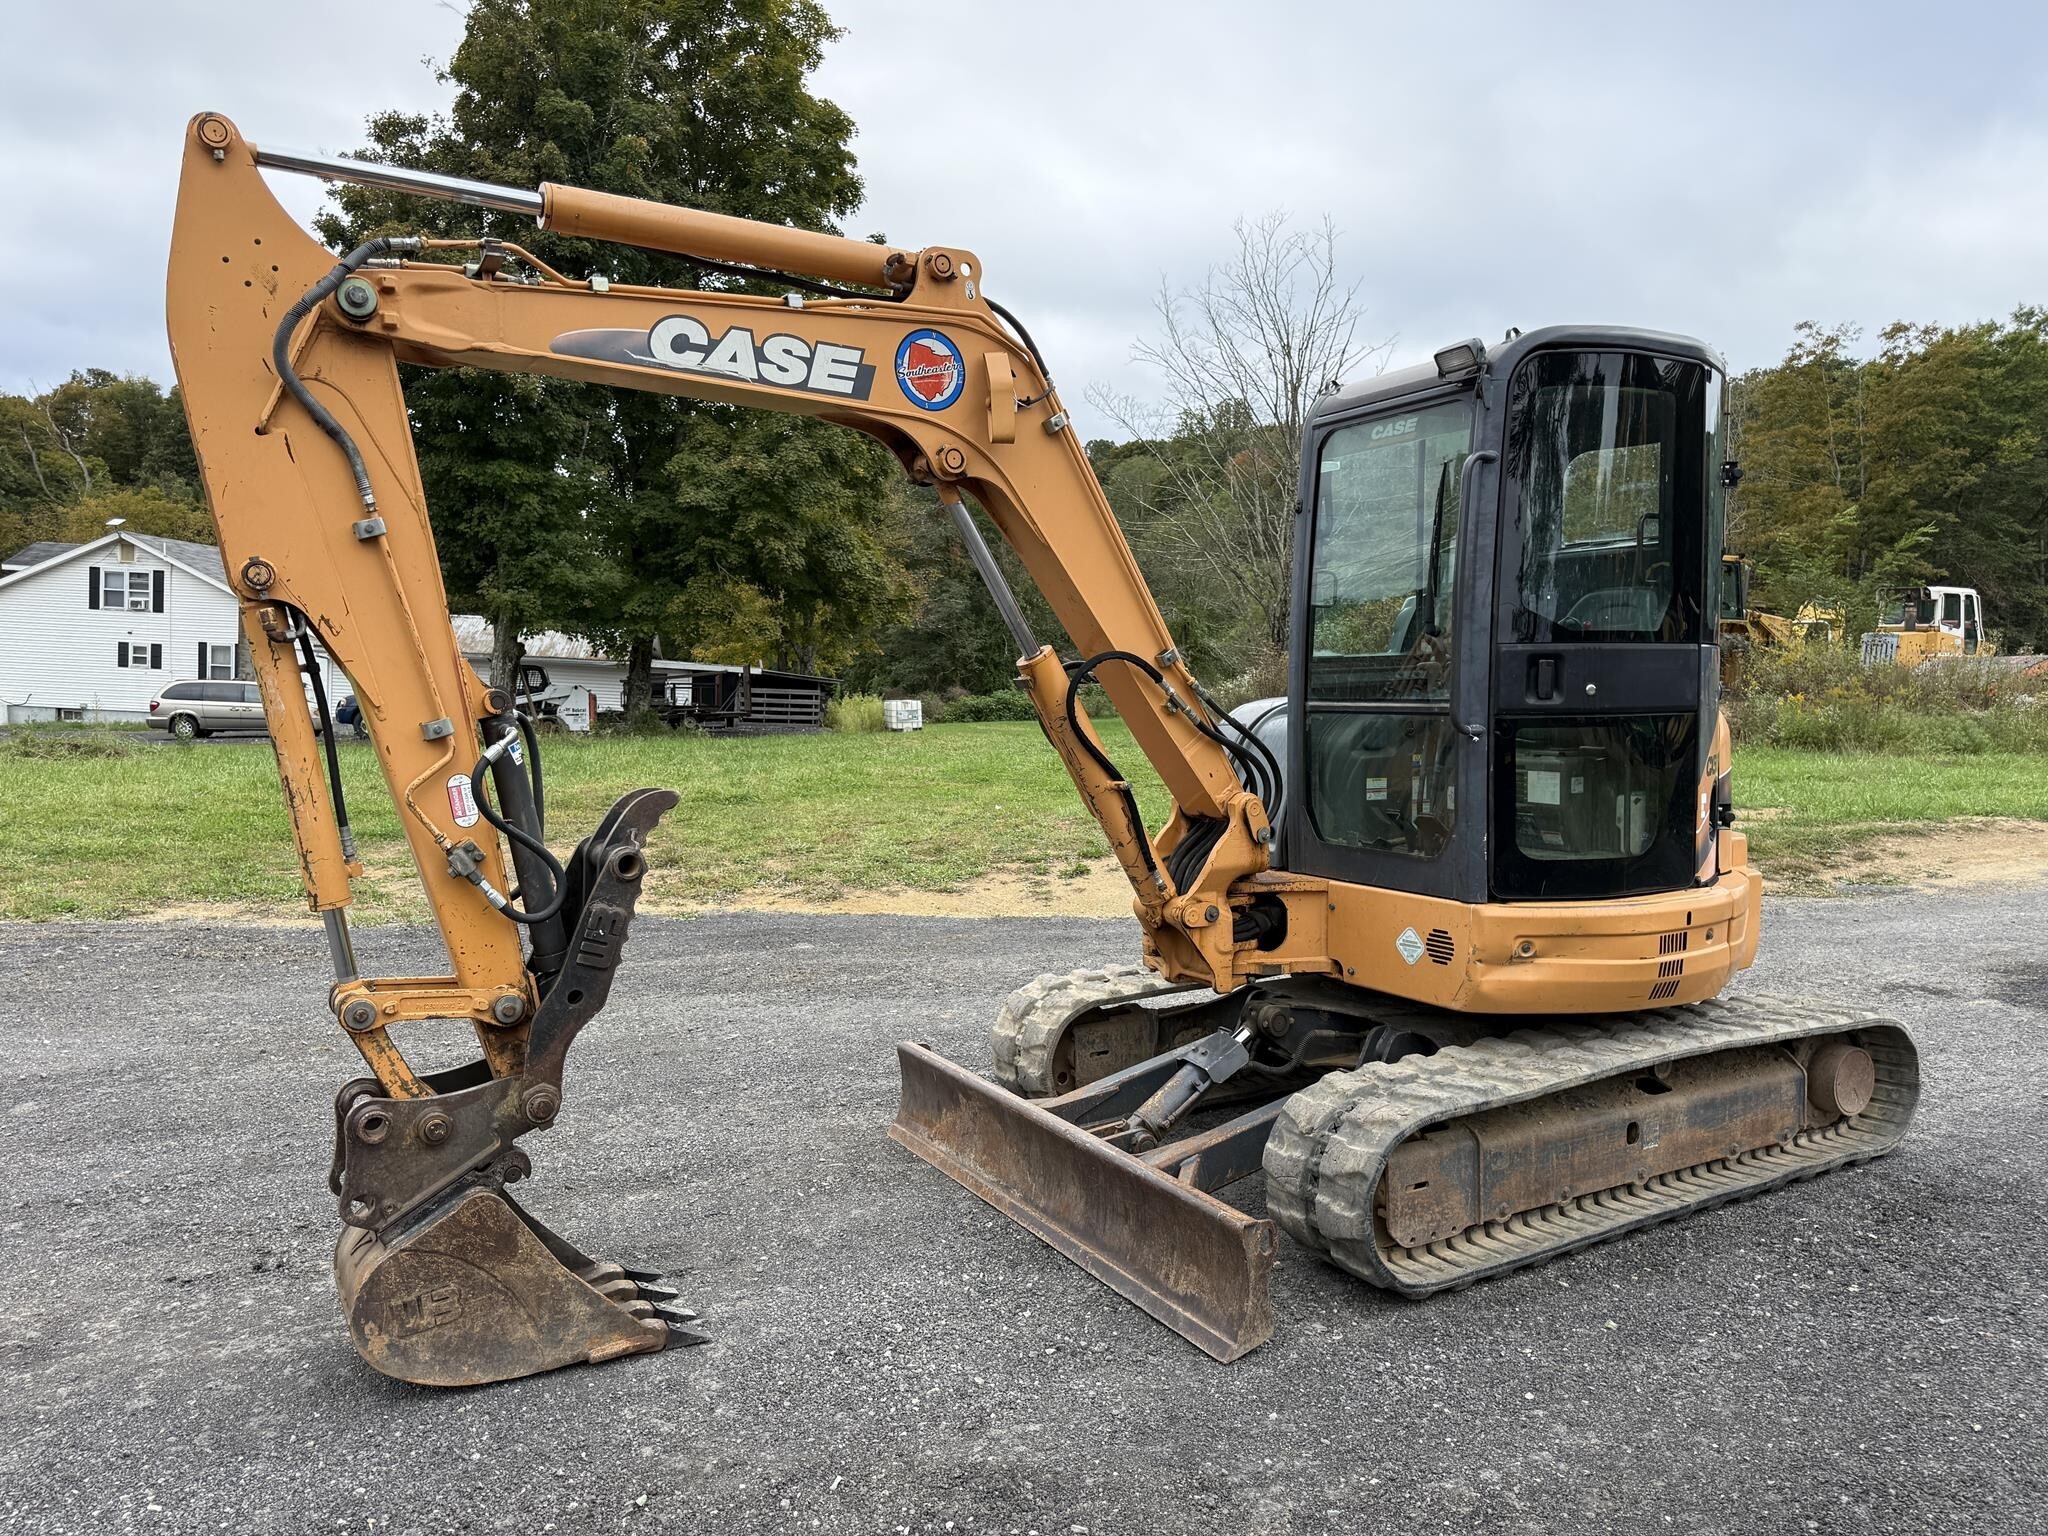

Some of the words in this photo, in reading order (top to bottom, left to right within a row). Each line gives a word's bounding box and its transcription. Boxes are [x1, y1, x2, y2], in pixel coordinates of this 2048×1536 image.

[650, 317, 863, 394] CASE
[897, 361, 963, 379] Southeastern
[1371, 417, 1419, 440] CASE
